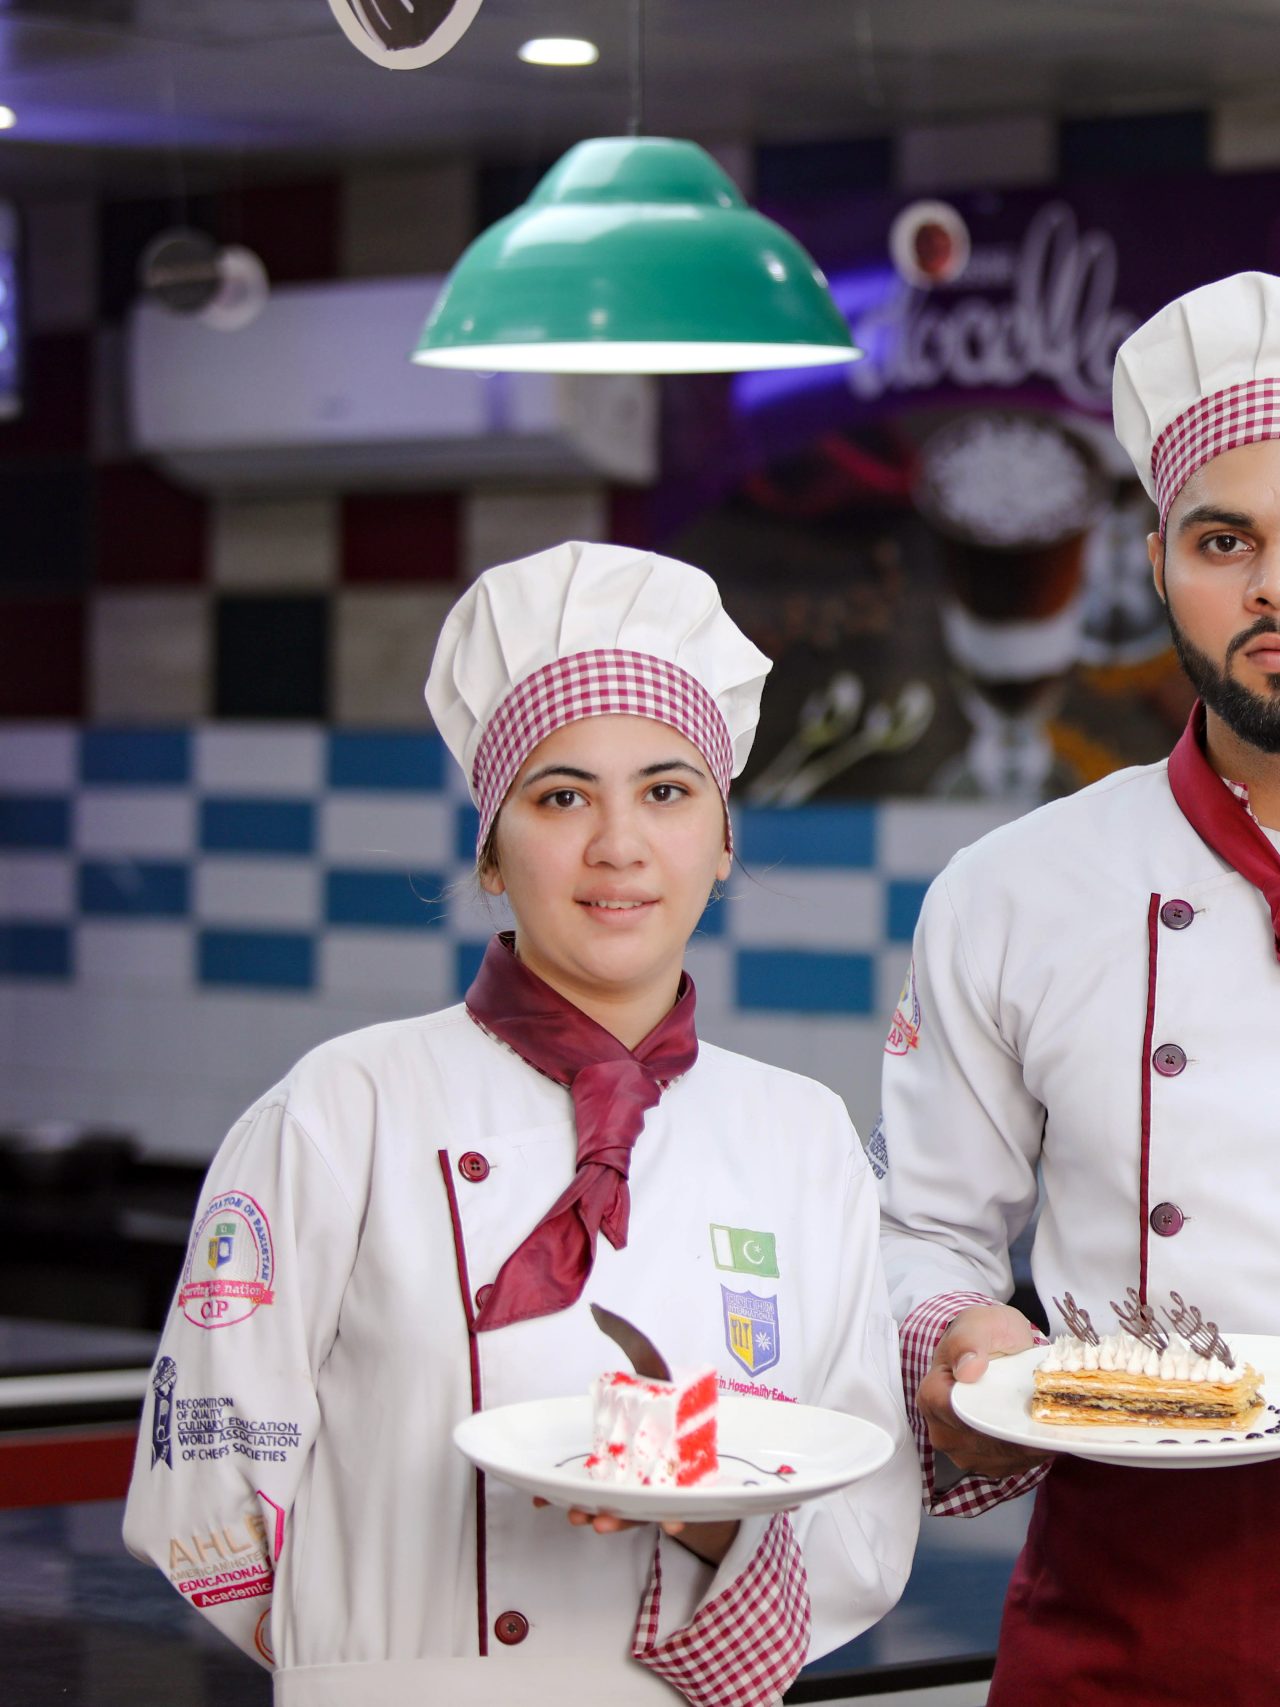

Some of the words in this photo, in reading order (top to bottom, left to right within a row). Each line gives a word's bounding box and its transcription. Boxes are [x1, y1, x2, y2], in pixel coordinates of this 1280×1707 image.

[887, 1027, 903, 1048] AP
[176, 1398, 234, 1410] RECOGNITION
[176, 1410, 188, 1420] OF
[192, 1408, 223, 1420] QUALITY
[177, 1420, 224, 1431] CULINARY
[228, 1417, 299, 1432] EDUCATION
[178, 1433, 214, 1446] WORLD
[219, 1429, 299, 1447] ASSOCIATION
[182, 1449, 196, 1461] OF
[197, 1445, 230, 1460] CHEFS
[232, 1443, 288, 1462] SOCIETIES
[178, 1564, 269, 1593] EDUCATIONAL
[201, 1581, 272, 1606] Academic
